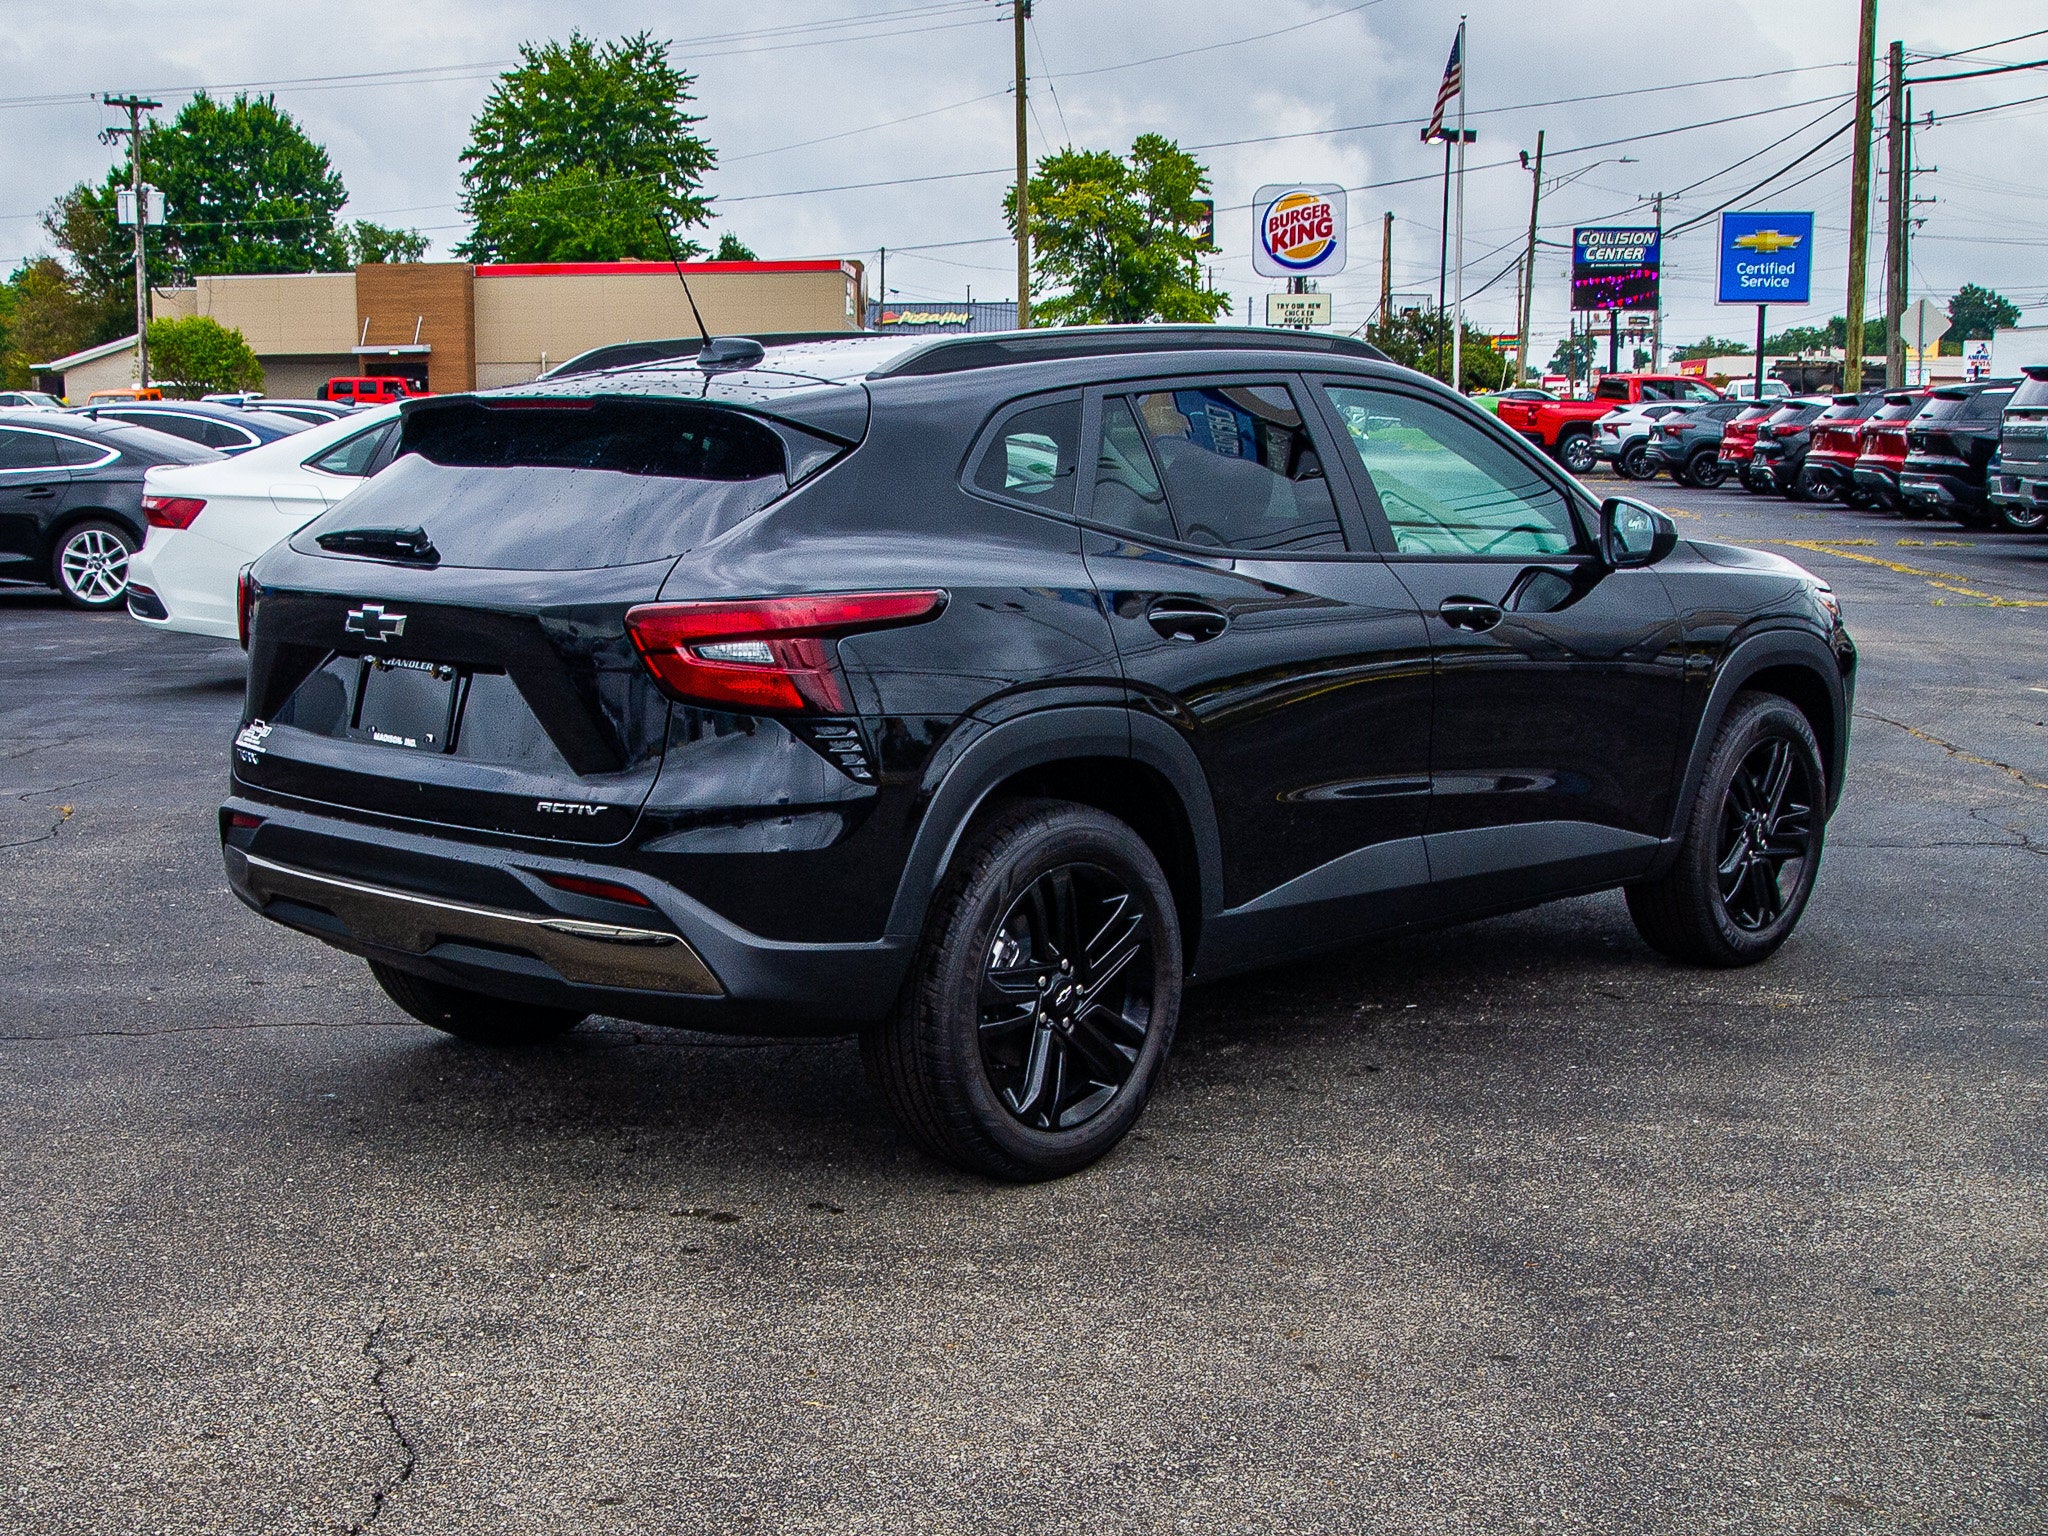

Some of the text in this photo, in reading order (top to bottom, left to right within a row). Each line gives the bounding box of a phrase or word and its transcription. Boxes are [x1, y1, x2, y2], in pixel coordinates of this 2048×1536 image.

[1269, 204, 1330, 234] BURGER
[1272, 217, 1333, 254] KING
[1578, 231, 1656, 245] COLLISION
[1585, 246, 1645, 261] CENTER
[1737, 262, 1795, 276] Certified
[1740, 274, 1790, 289] Service
[1276, 302, 1321, 310] TRY OUR NEW
[898, 311, 940, 325] Pizza
[536, 801, 609, 816] ACTIV
